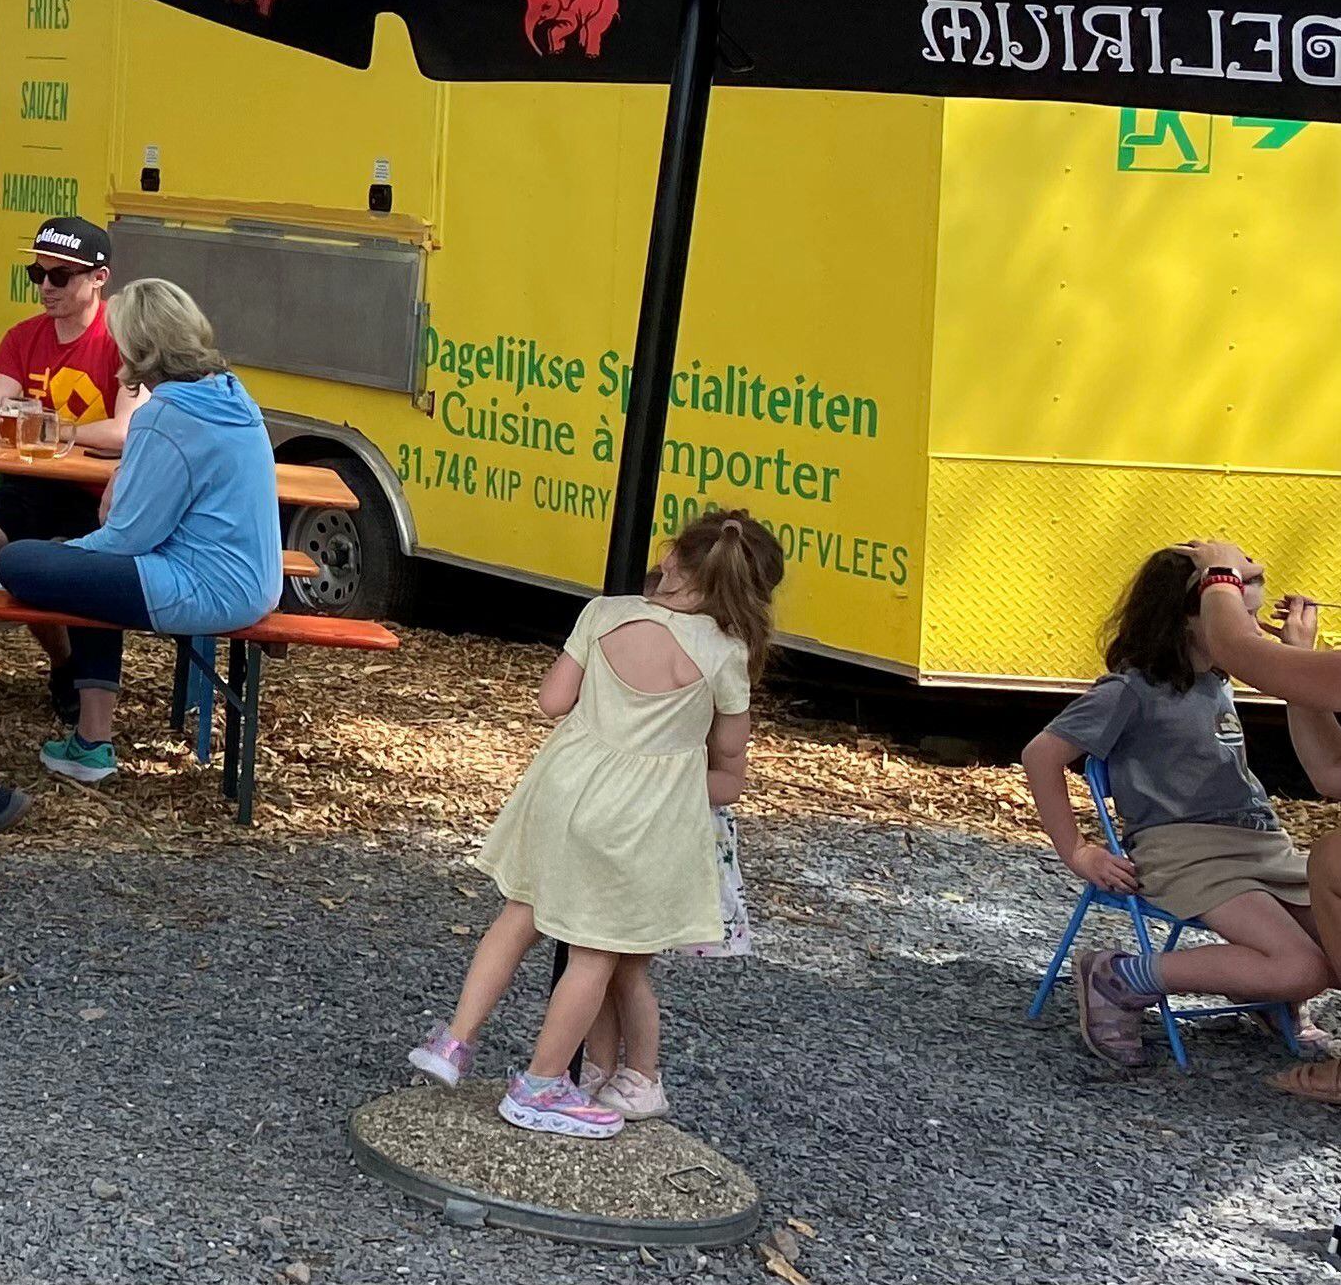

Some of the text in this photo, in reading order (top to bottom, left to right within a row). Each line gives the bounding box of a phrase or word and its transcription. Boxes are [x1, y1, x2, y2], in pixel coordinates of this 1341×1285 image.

[21, 81, 68, 121] SAUZEN
[2, 173, 78, 217] HAMBURGER
[420, 326, 585, 395] Dagelijkse
[442, 390, 840, 503] Cuisine à mporter
[398, 443, 477, 495] 31,74€
[486, 466, 521, 502] KIP
[534, 475, 611, 522] CURRY
